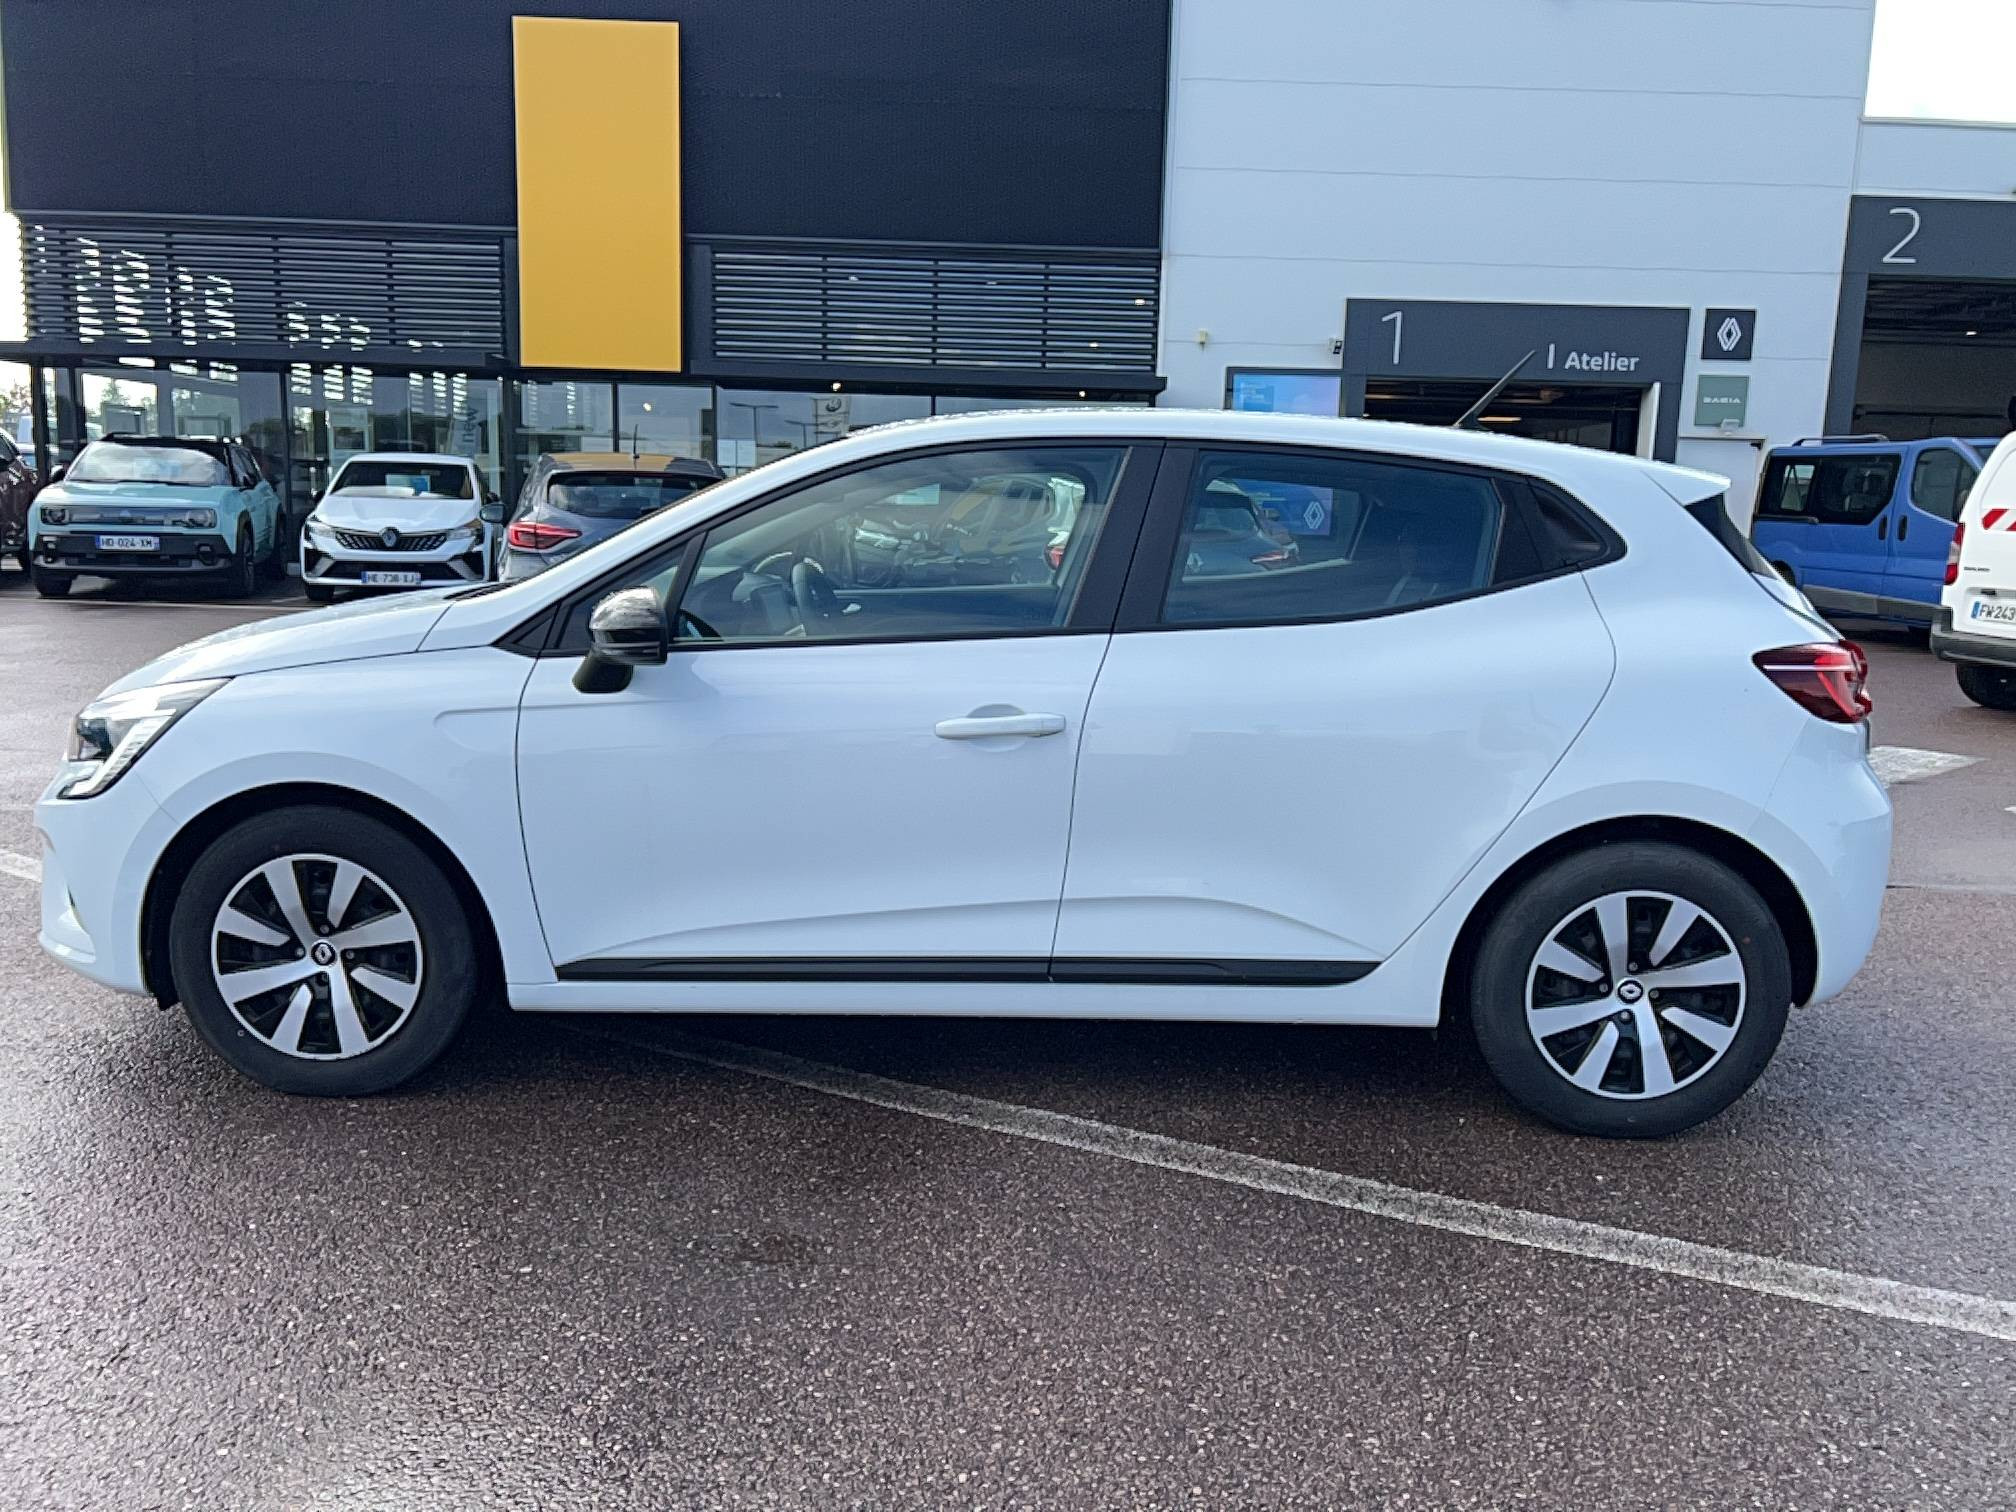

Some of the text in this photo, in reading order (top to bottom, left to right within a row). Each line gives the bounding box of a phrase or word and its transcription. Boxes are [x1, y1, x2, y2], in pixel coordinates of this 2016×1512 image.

[1882, 207, 1920, 263] 2
[1381, 311, 1402, 365] 1
[1564, 351, 1640, 372] Atelier
